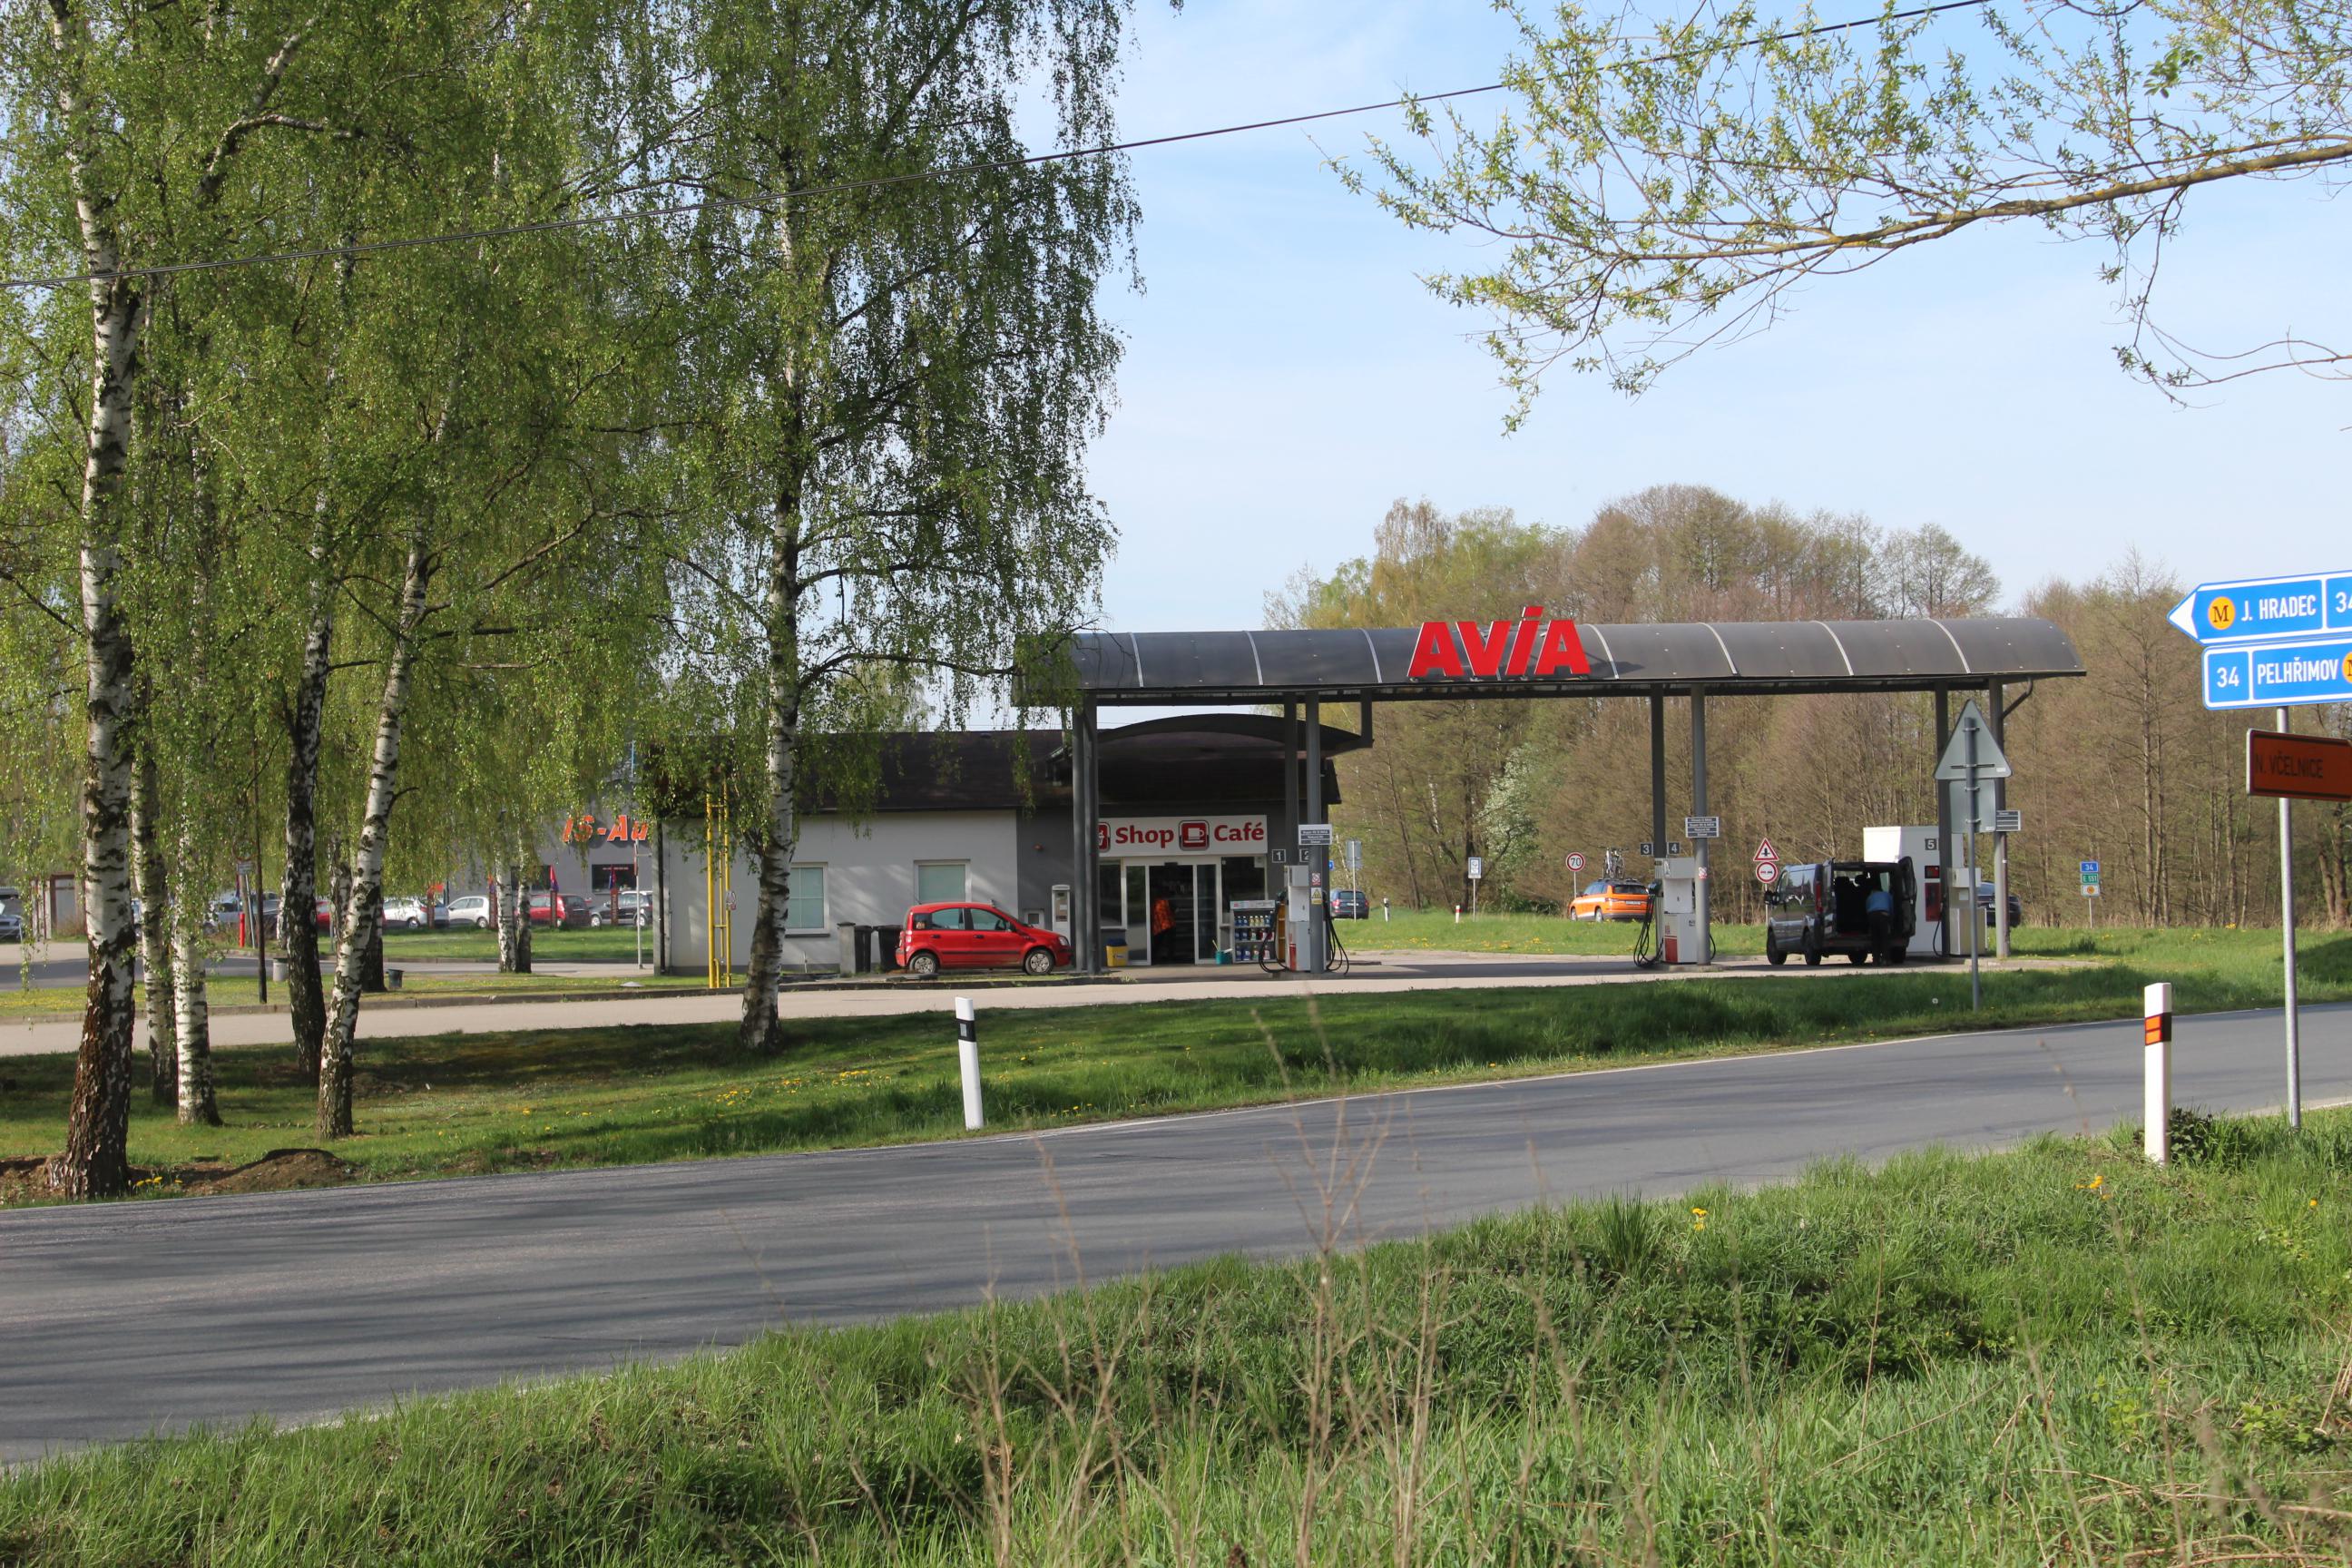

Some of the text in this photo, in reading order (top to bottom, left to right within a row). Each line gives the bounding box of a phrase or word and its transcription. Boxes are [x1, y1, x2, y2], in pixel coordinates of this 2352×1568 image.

[2212, 594, 2317, 623] M J. HRADEC
[2216, 666, 2239, 689] 34
[2257, 657, 2338, 685] PELHŘIMOV
[2269, 750, 2324, 779] VČELNICE
[1114, 821, 1264, 849] Shop Café
[1642, 844, 1651, 855] 3
[1671, 843, 1678, 853] 4
[1926, 839, 1935, 849] 5
[1276, 851, 1281, 861] 1
[1570, 858, 1582, 867] 70
